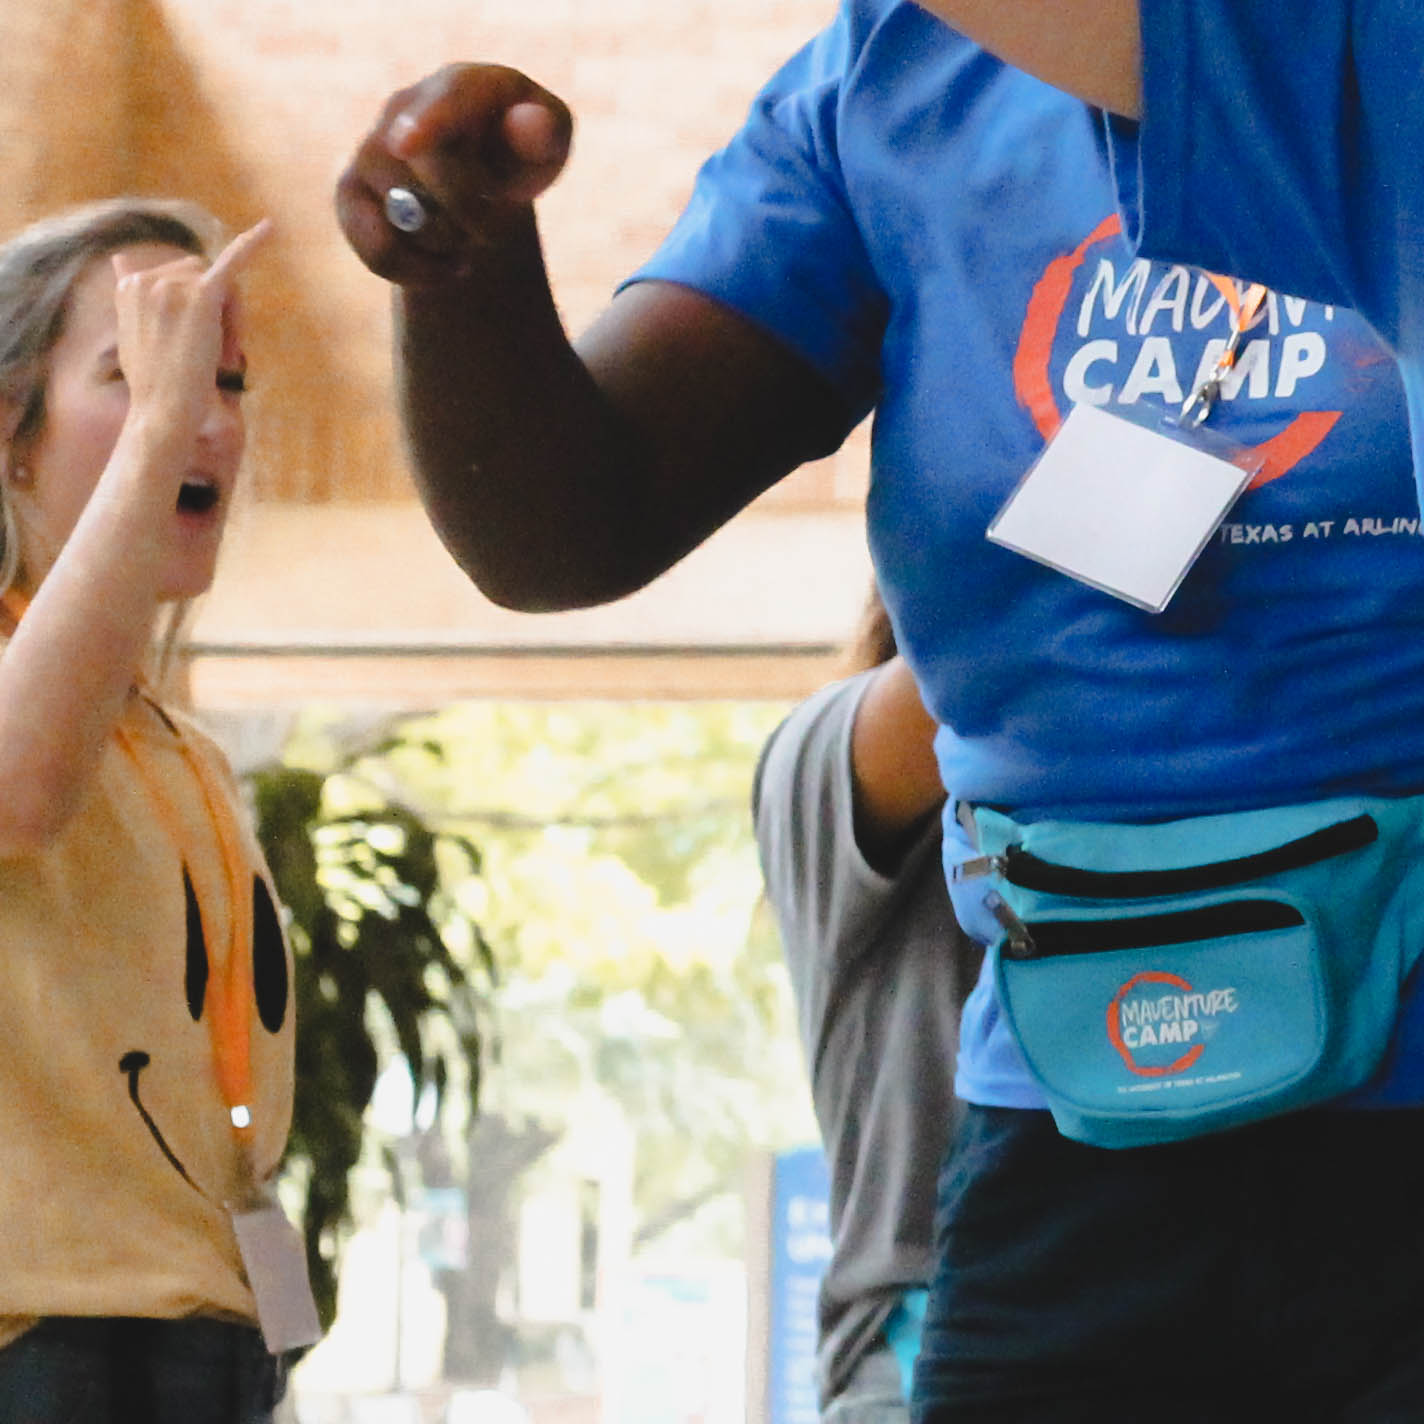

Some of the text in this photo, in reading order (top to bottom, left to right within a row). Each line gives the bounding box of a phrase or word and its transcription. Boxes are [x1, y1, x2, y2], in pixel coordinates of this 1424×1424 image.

[1063, 331, 1326, 405] CAMP
[1220, 517, 1424, 545] TEXAS AT ARLIN
[1121, 987, 1240, 1027] MAVENTURE
[1123, 1020, 1199, 1049] CAMP
